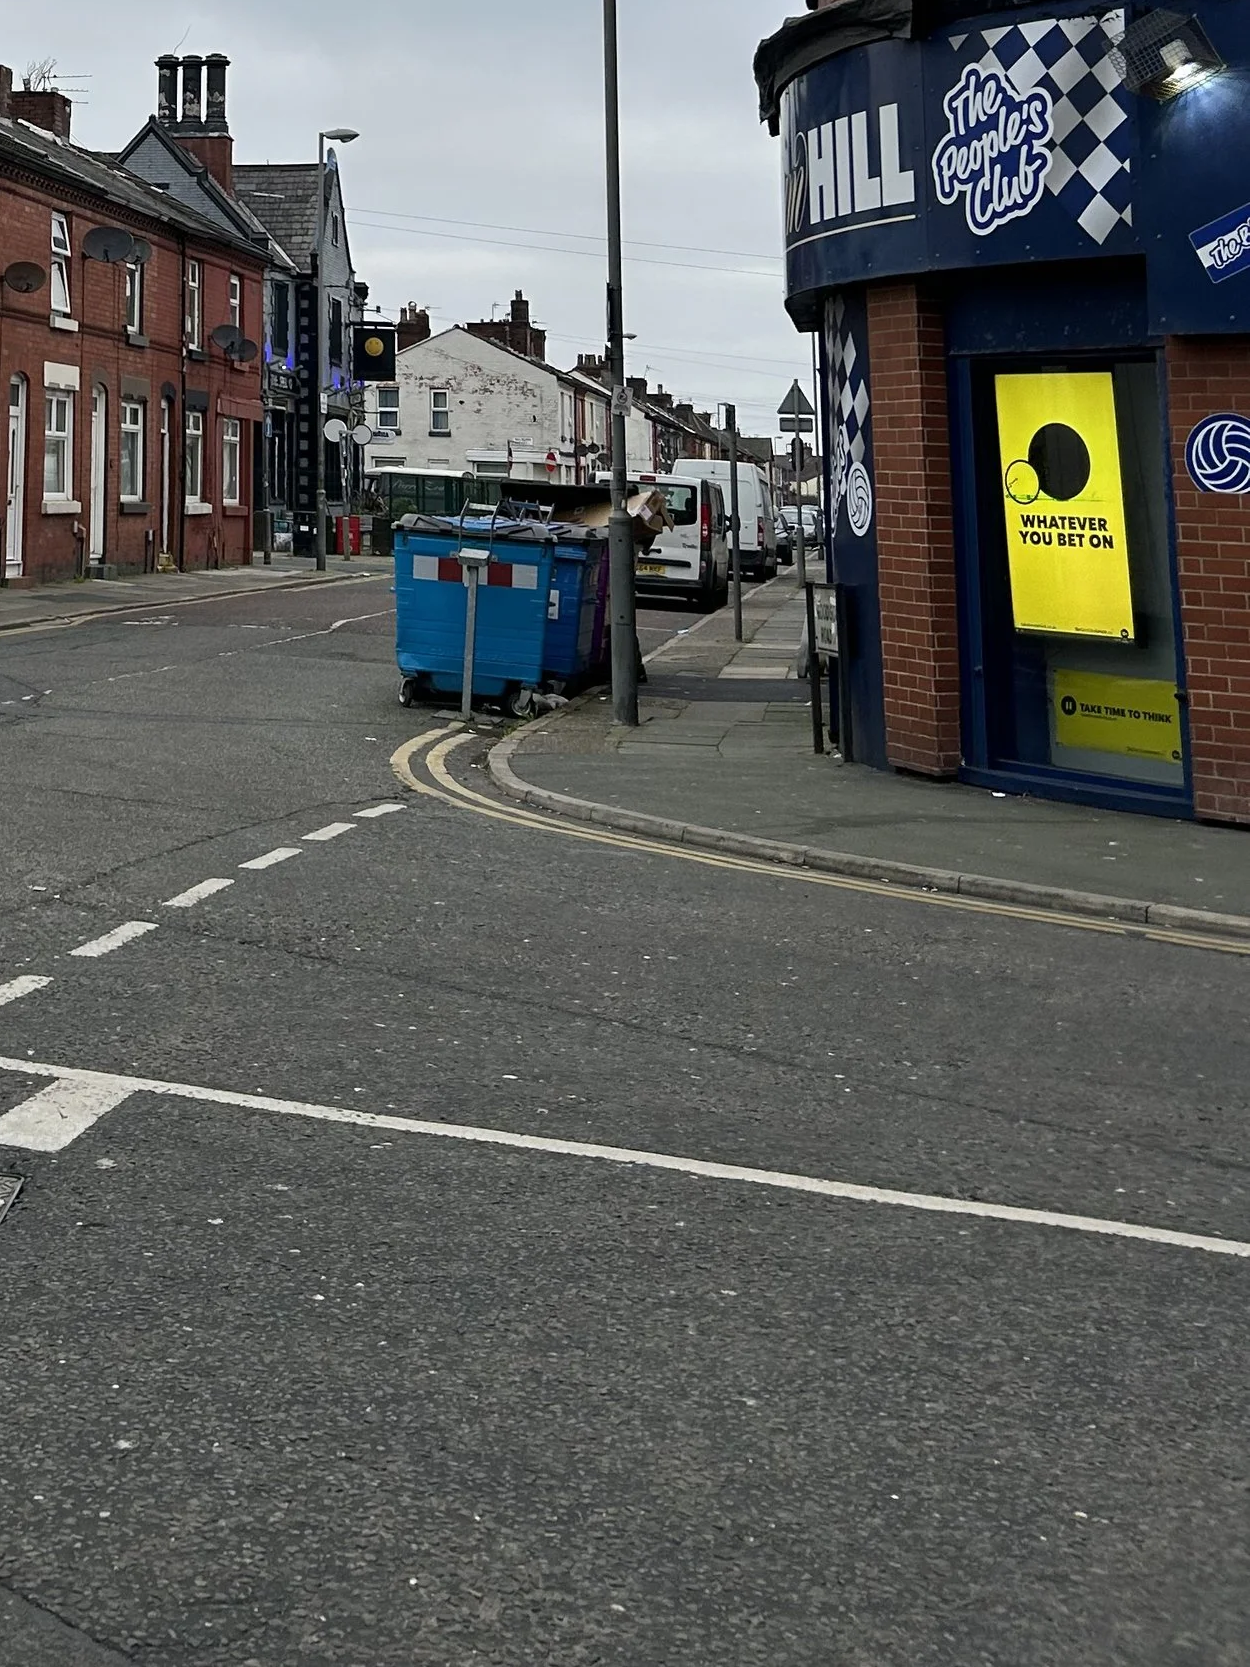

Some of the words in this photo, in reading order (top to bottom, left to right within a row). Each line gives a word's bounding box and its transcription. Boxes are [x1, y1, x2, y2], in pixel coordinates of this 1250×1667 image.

[952, 75, 1002, 135] The
[807, 102, 915, 225] HILL
[940, 100, 1043, 192] People's
[974, 144, 1042, 223] Club
[1210, 237, 1241, 267] The
[1019, 530, 1053, 546] YOU
[1057, 532, 1085, 548] BET
[1088, 533, 1114, 549] ON
[1020, 513, 1109, 532] WHATEVER
[1079, 702, 1102, 715] TAKE
[1104, 705, 1126, 718] TIME
[1127, 708, 1141, 720] TO
[1142, 710, 1172, 724] THINK
